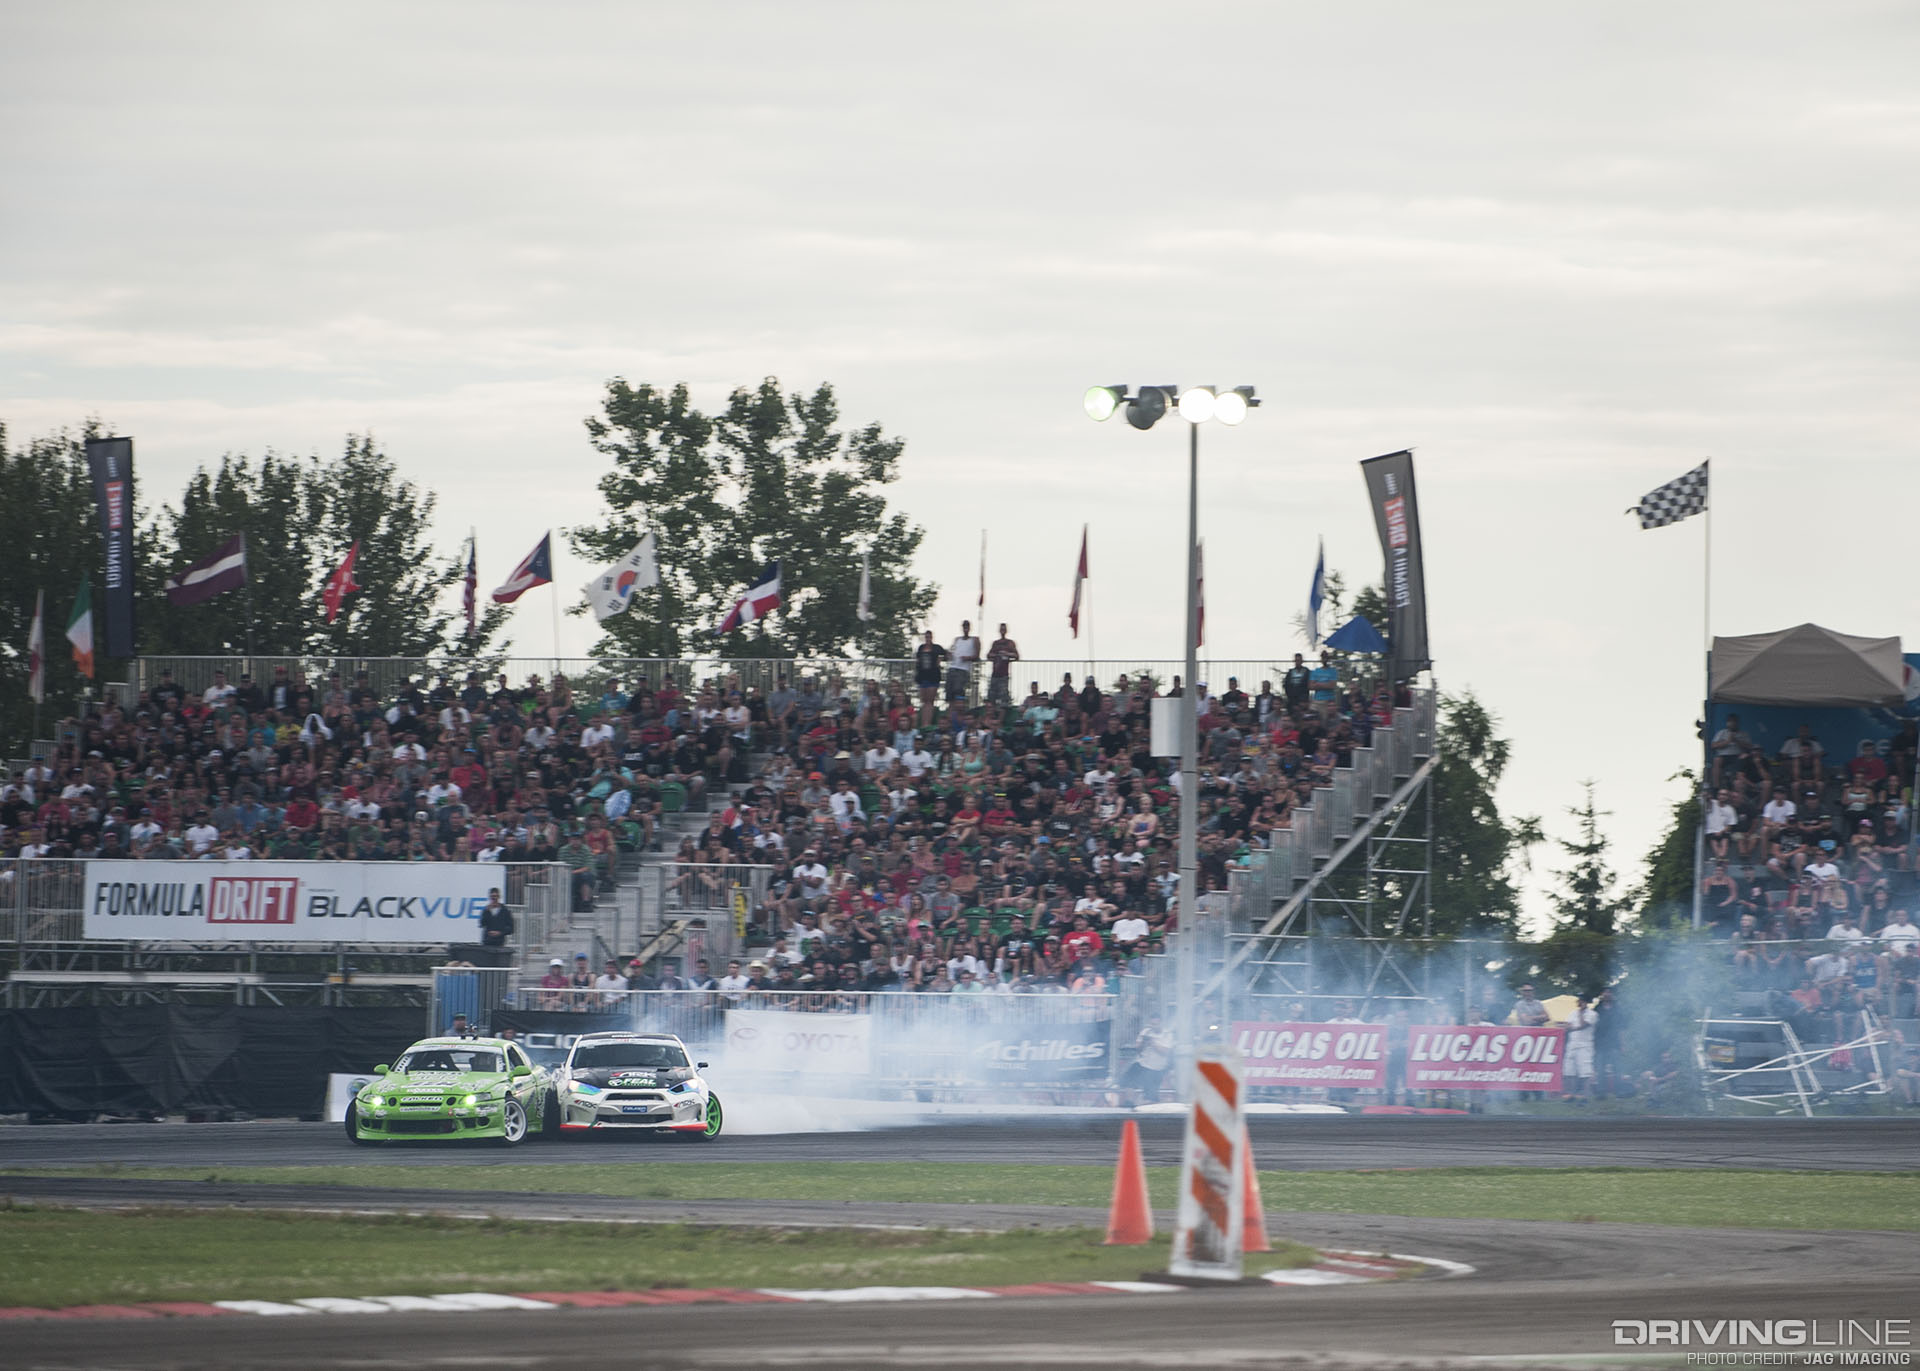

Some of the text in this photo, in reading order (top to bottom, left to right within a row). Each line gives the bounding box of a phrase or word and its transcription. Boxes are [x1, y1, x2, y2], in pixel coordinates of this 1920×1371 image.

[93, 879, 295, 921] FORMULA DRIFT
[306, 896, 489, 919] BLACKVUE
[973, 1039, 1106, 1061] Achilles
[1237, 1030, 1381, 1061] LUCAS OIL
[1410, 1033, 1559, 1064] LUCAS OIL
